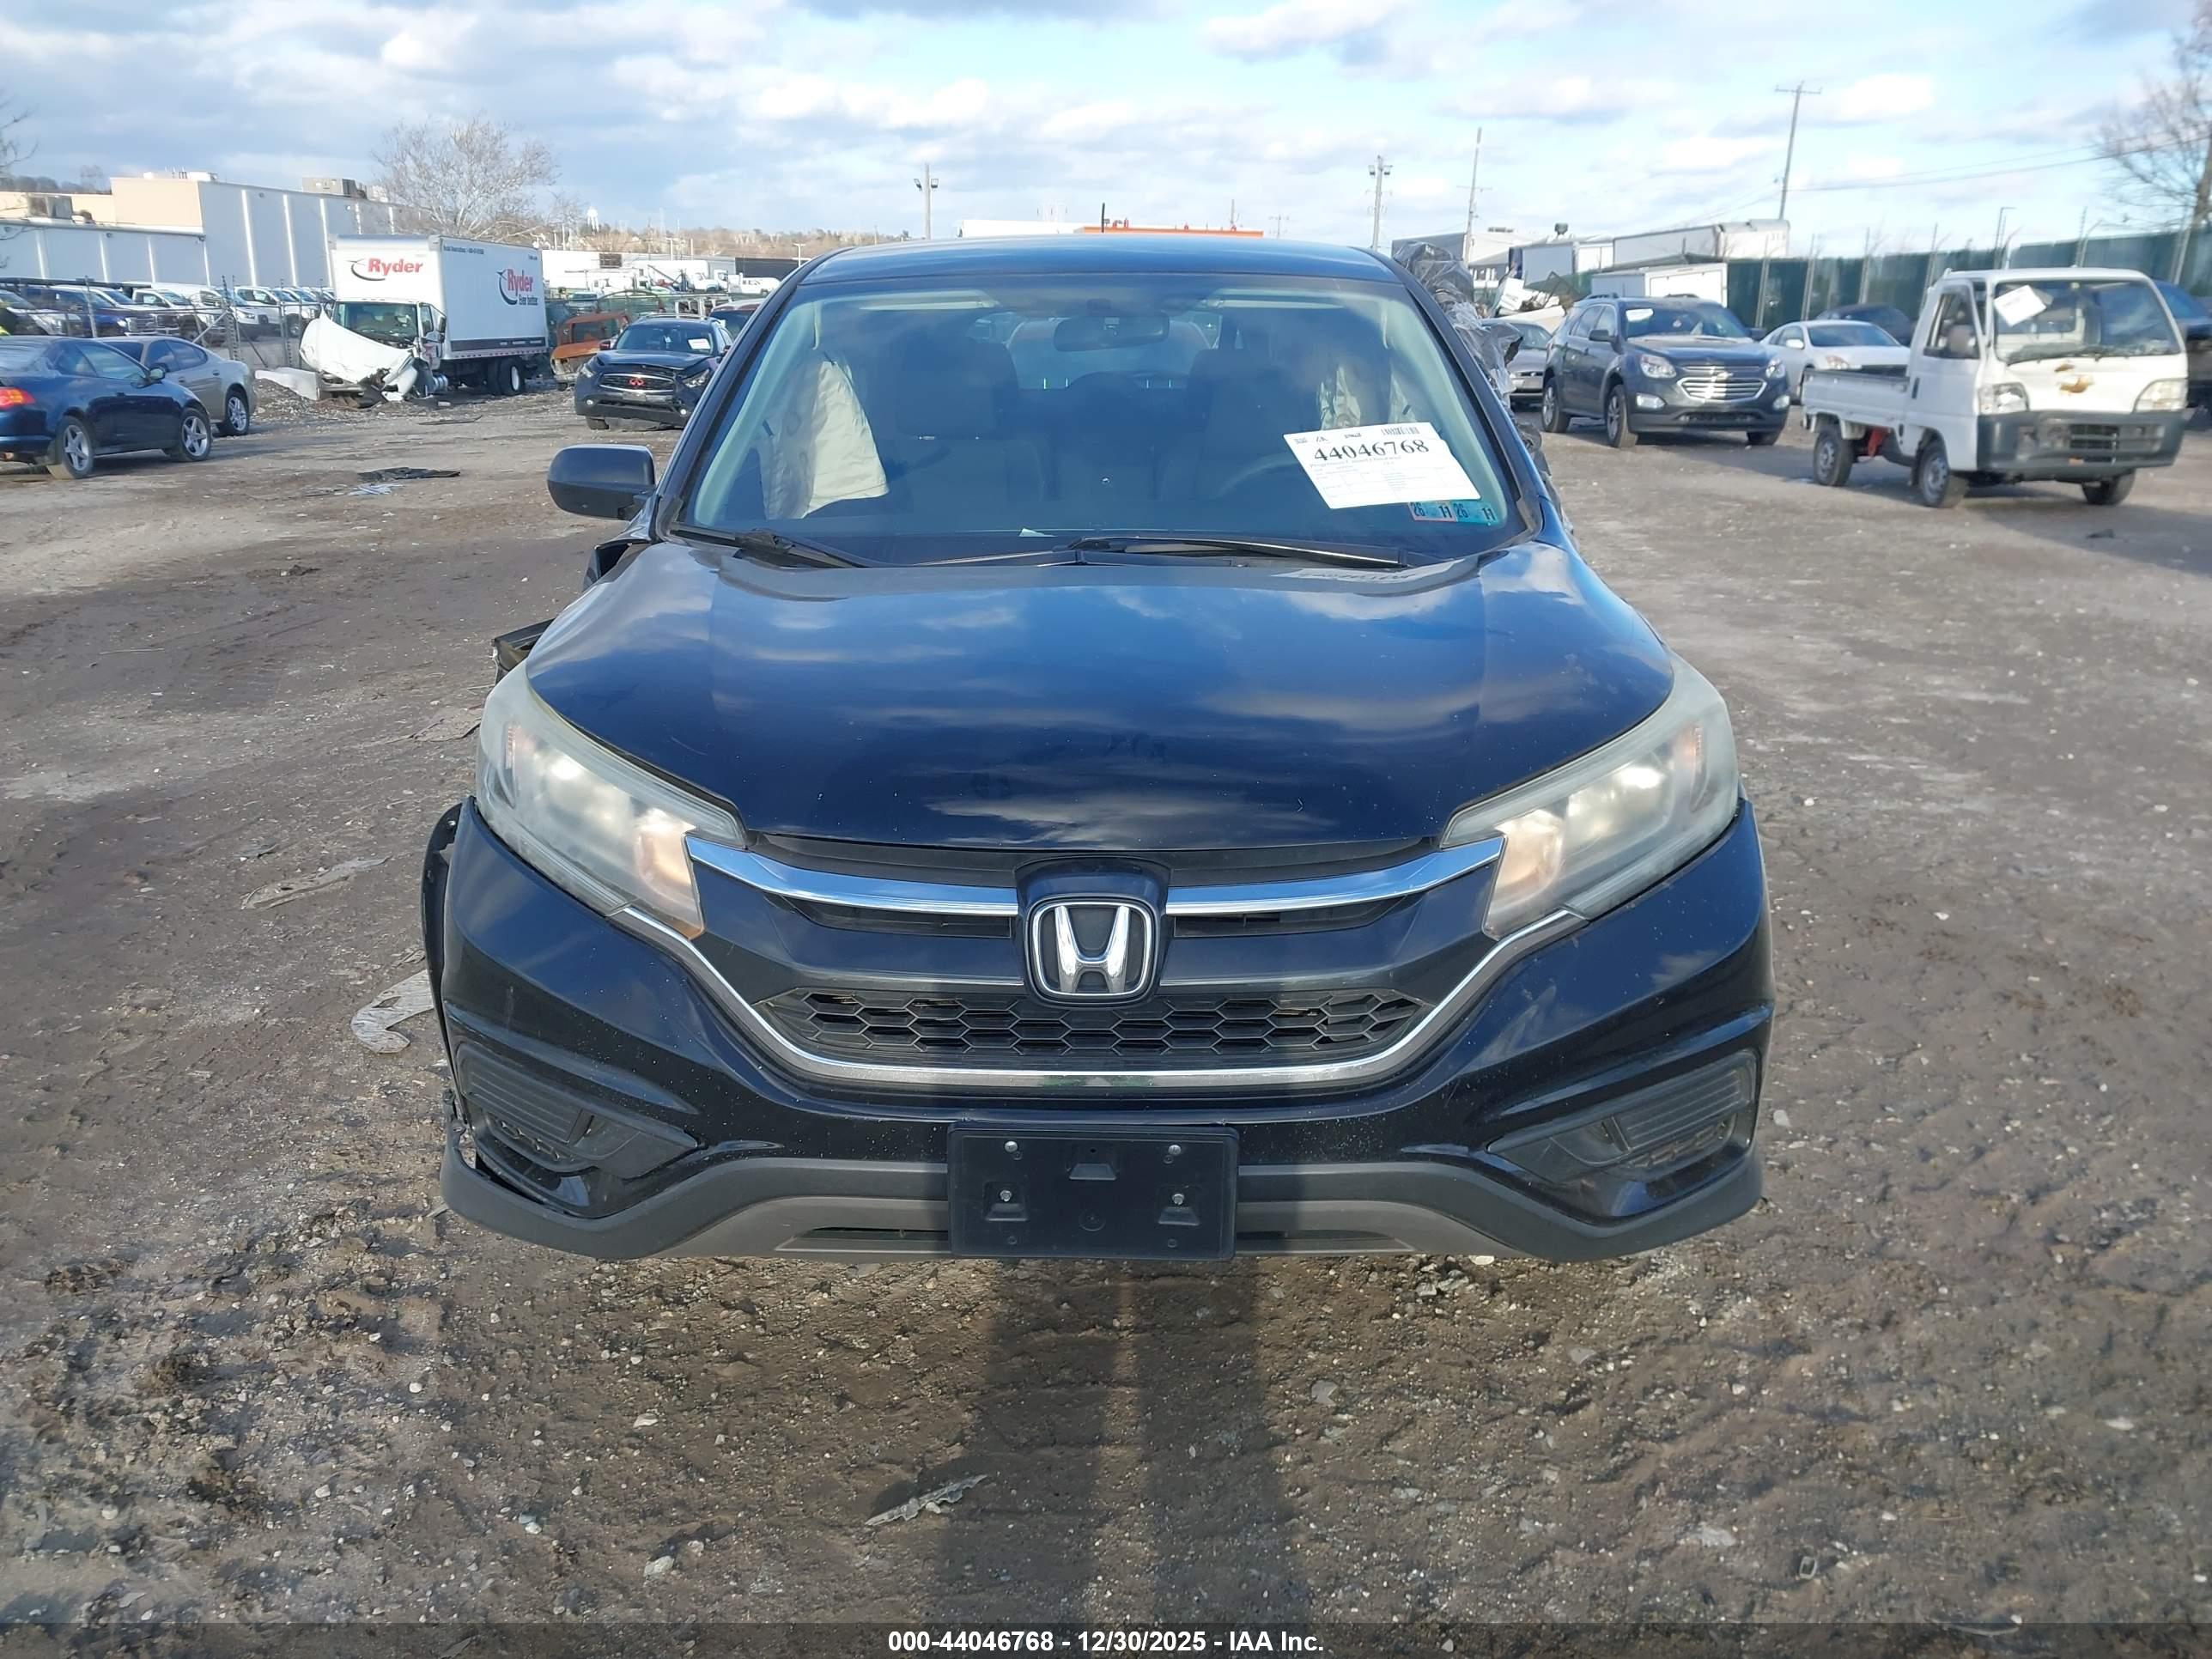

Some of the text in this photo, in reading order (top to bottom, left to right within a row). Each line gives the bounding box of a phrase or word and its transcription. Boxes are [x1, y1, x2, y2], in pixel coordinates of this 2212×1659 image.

[368, 258, 423, 276] Ryder
[507, 269, 533, 296] Ryder
[1315, 439, 1430, 461] 44046768
[1410, 501, 1453, 518] 26 11
[1453, 502, 1496, 520] 26 11
